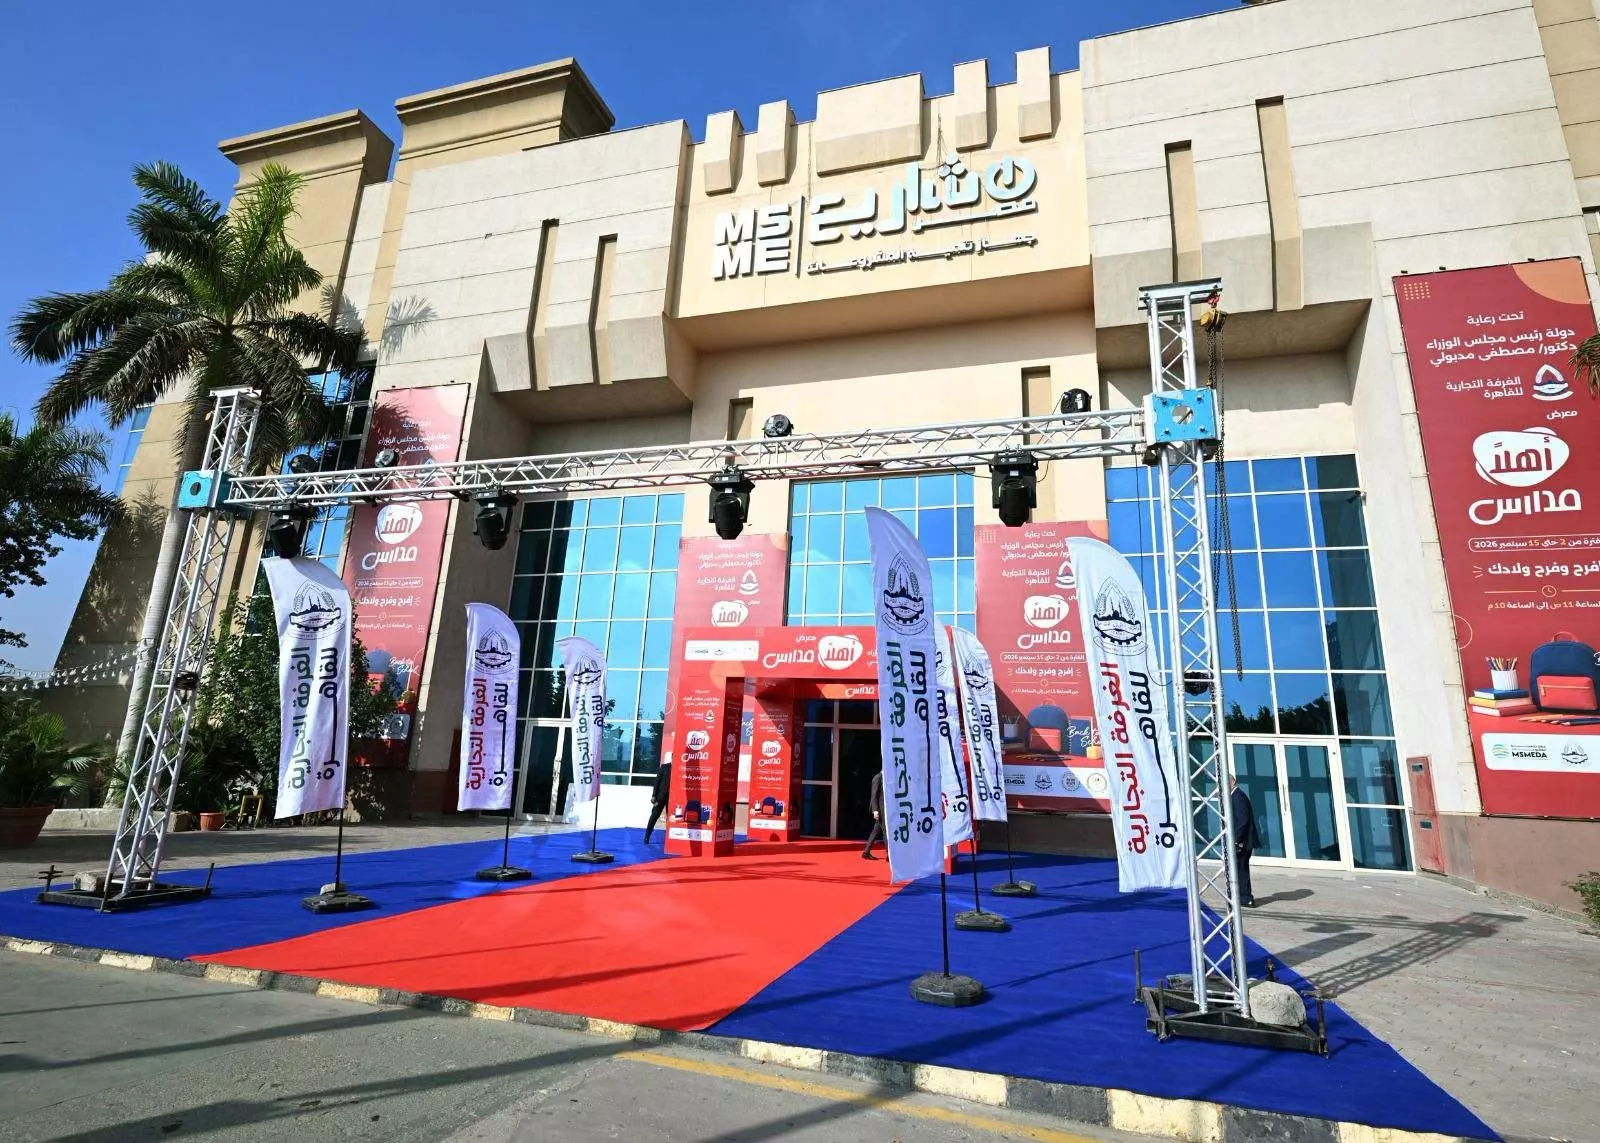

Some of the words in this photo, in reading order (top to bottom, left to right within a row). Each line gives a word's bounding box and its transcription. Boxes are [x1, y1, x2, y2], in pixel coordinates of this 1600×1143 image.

[715, 203, 792, 246] MS
[713, 240, 791, 281] ME
[1466, 315, 1496, 326] رعاية
[1498, 311, 1524, 322] تحت
[1465, 334, 1507, 347] مجلس
[1510, 329, 1543, 343] رئيس
[1546, 327, 1575, 339] دولة
[1426, 337, 1461, 350] الوزراء
[1430, 353, 1475, 367] مدبولي
[1478, 345, 1535, 361] مصطفى
[1446, 380, 1483, 392] التجارية
[1486, 376, 1521, 390] الغرفة
[1484, 387, 1523, 400] للقاهرة
[1546, 410, 1577, 420] معرض
[1468, 489, 1582, 526] مدارس
[1474, 541, 1498, 549] 2026
[1500, 541, 1528, 549] سبتمبر
[362, 546, 417, 570] مدارس
[1535, 562, 1569, 577] وفرح
[796, 634, 816, 643] معرض
[1017, 630, 1071, 649] مدارس
[763, 649, 814, 669] مدارس
[291, 646, 314, 708] الغرفة
[845, 686, 875, 698] مدارس
[886, 641, 909, 729] الغرفة
[470, 678, 489, 727] الغرفة
[1100, 662, 1131, 744] الغرفة
[1067, 726, 1090, 737] Back
[288, 713, 312, 790] التجارية
[466, 731, 487, 790] التجارية
[577, 736, 594, 785] التجارية
[893, 737, 914, 844] التجارية
[1115, 752, 1151, 855] التجارية
